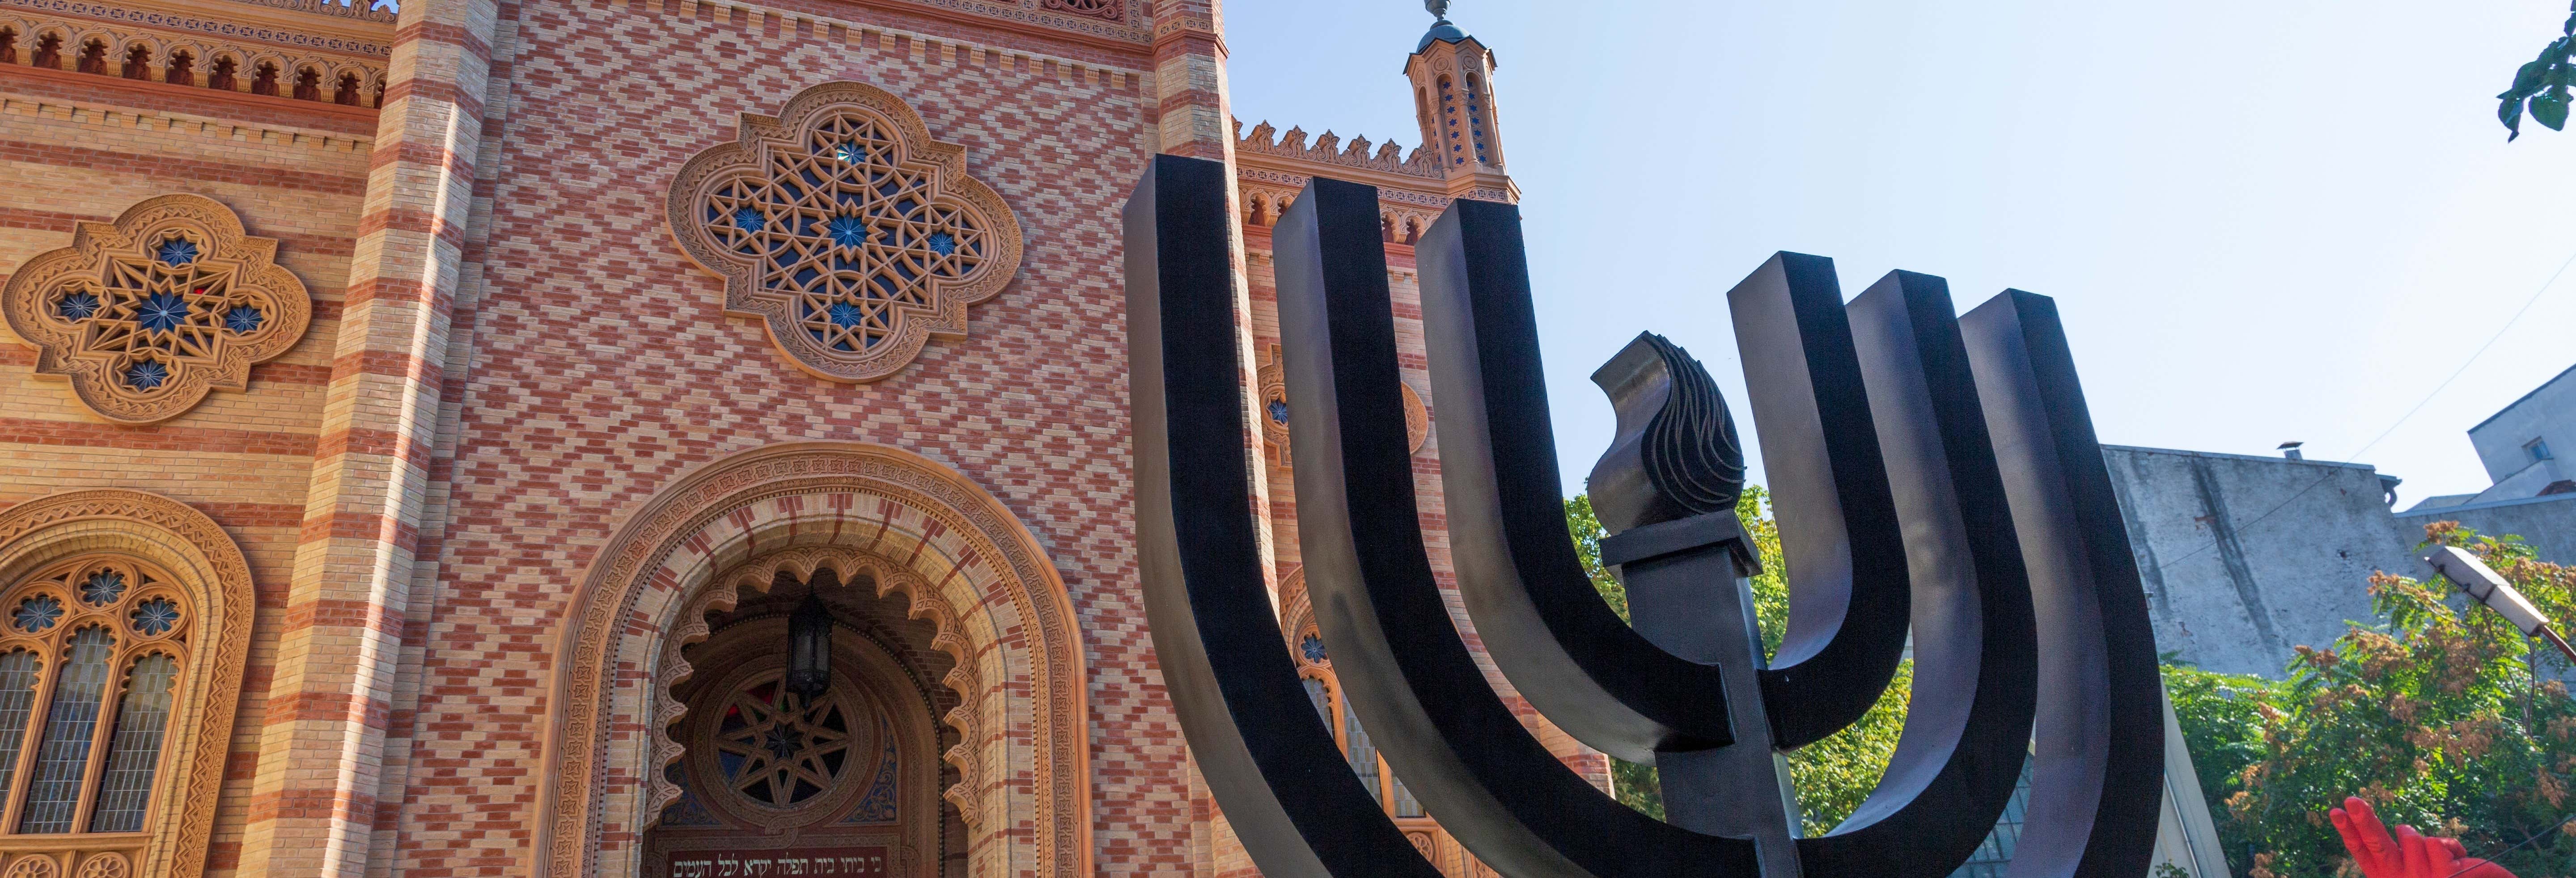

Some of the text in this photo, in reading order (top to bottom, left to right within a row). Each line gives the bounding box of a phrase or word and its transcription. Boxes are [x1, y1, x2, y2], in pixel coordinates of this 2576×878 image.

[674, 852, 881, 878] כי ביתי בית תפלה יקרא לכל העמים
